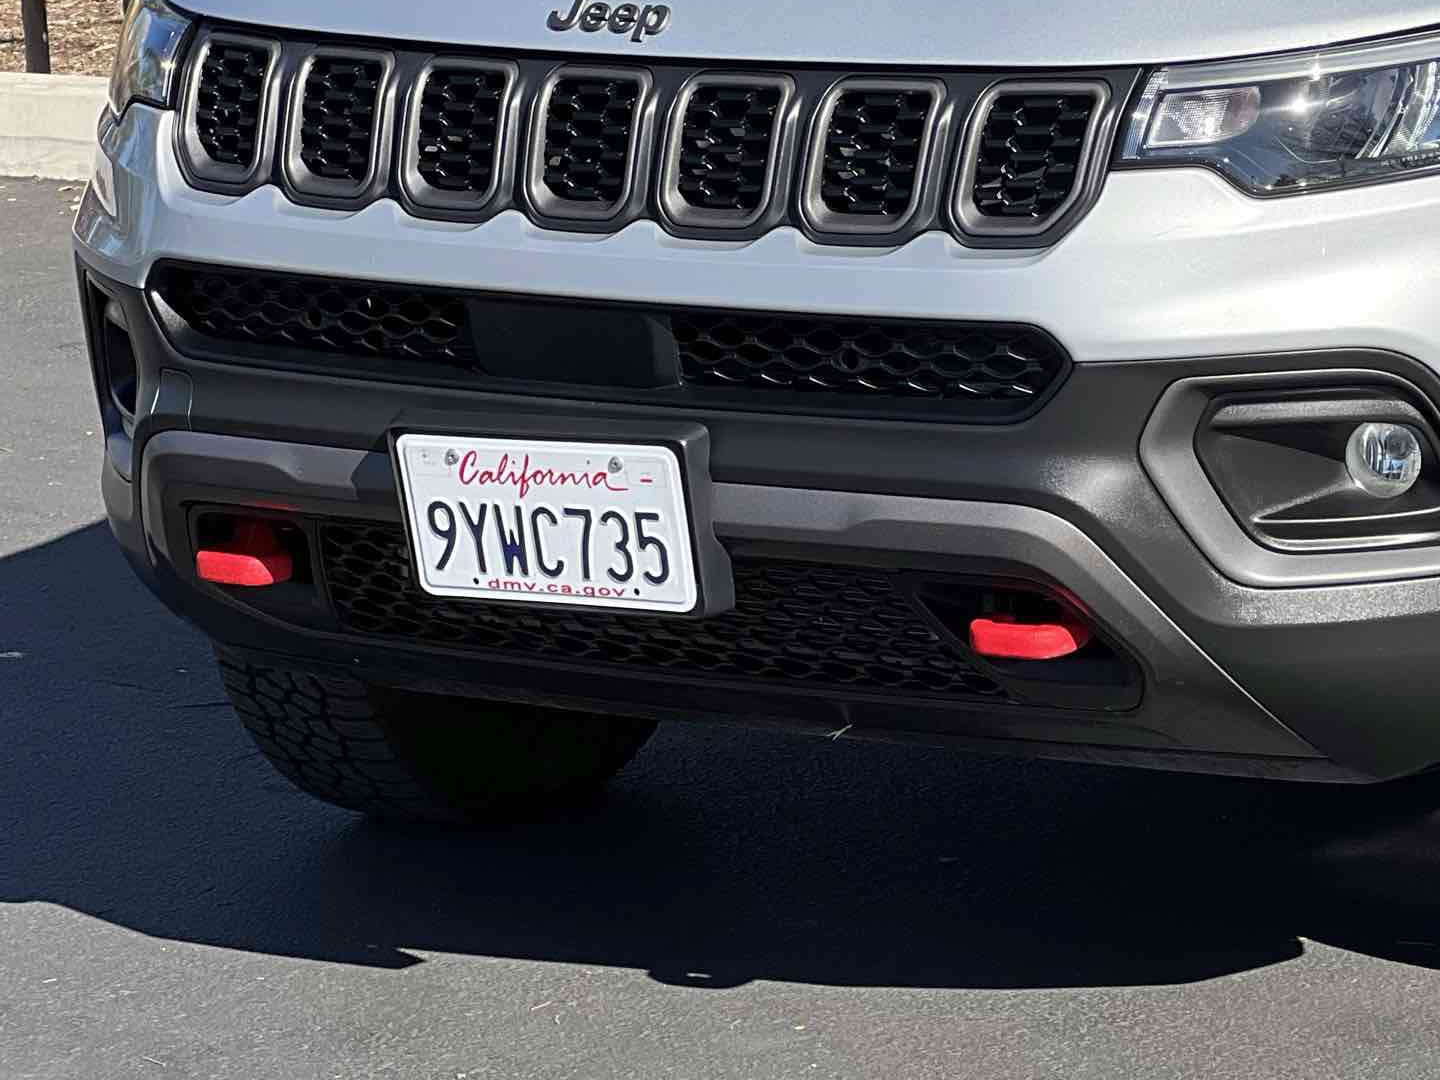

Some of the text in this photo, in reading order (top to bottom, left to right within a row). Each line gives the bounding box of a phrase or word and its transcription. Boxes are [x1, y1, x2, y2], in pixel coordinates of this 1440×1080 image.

[458, 450, 629, 498] California
[427, 500, 669, 585] 9YWC735
[487, 577, 625, 598] dmv.ca.gov
